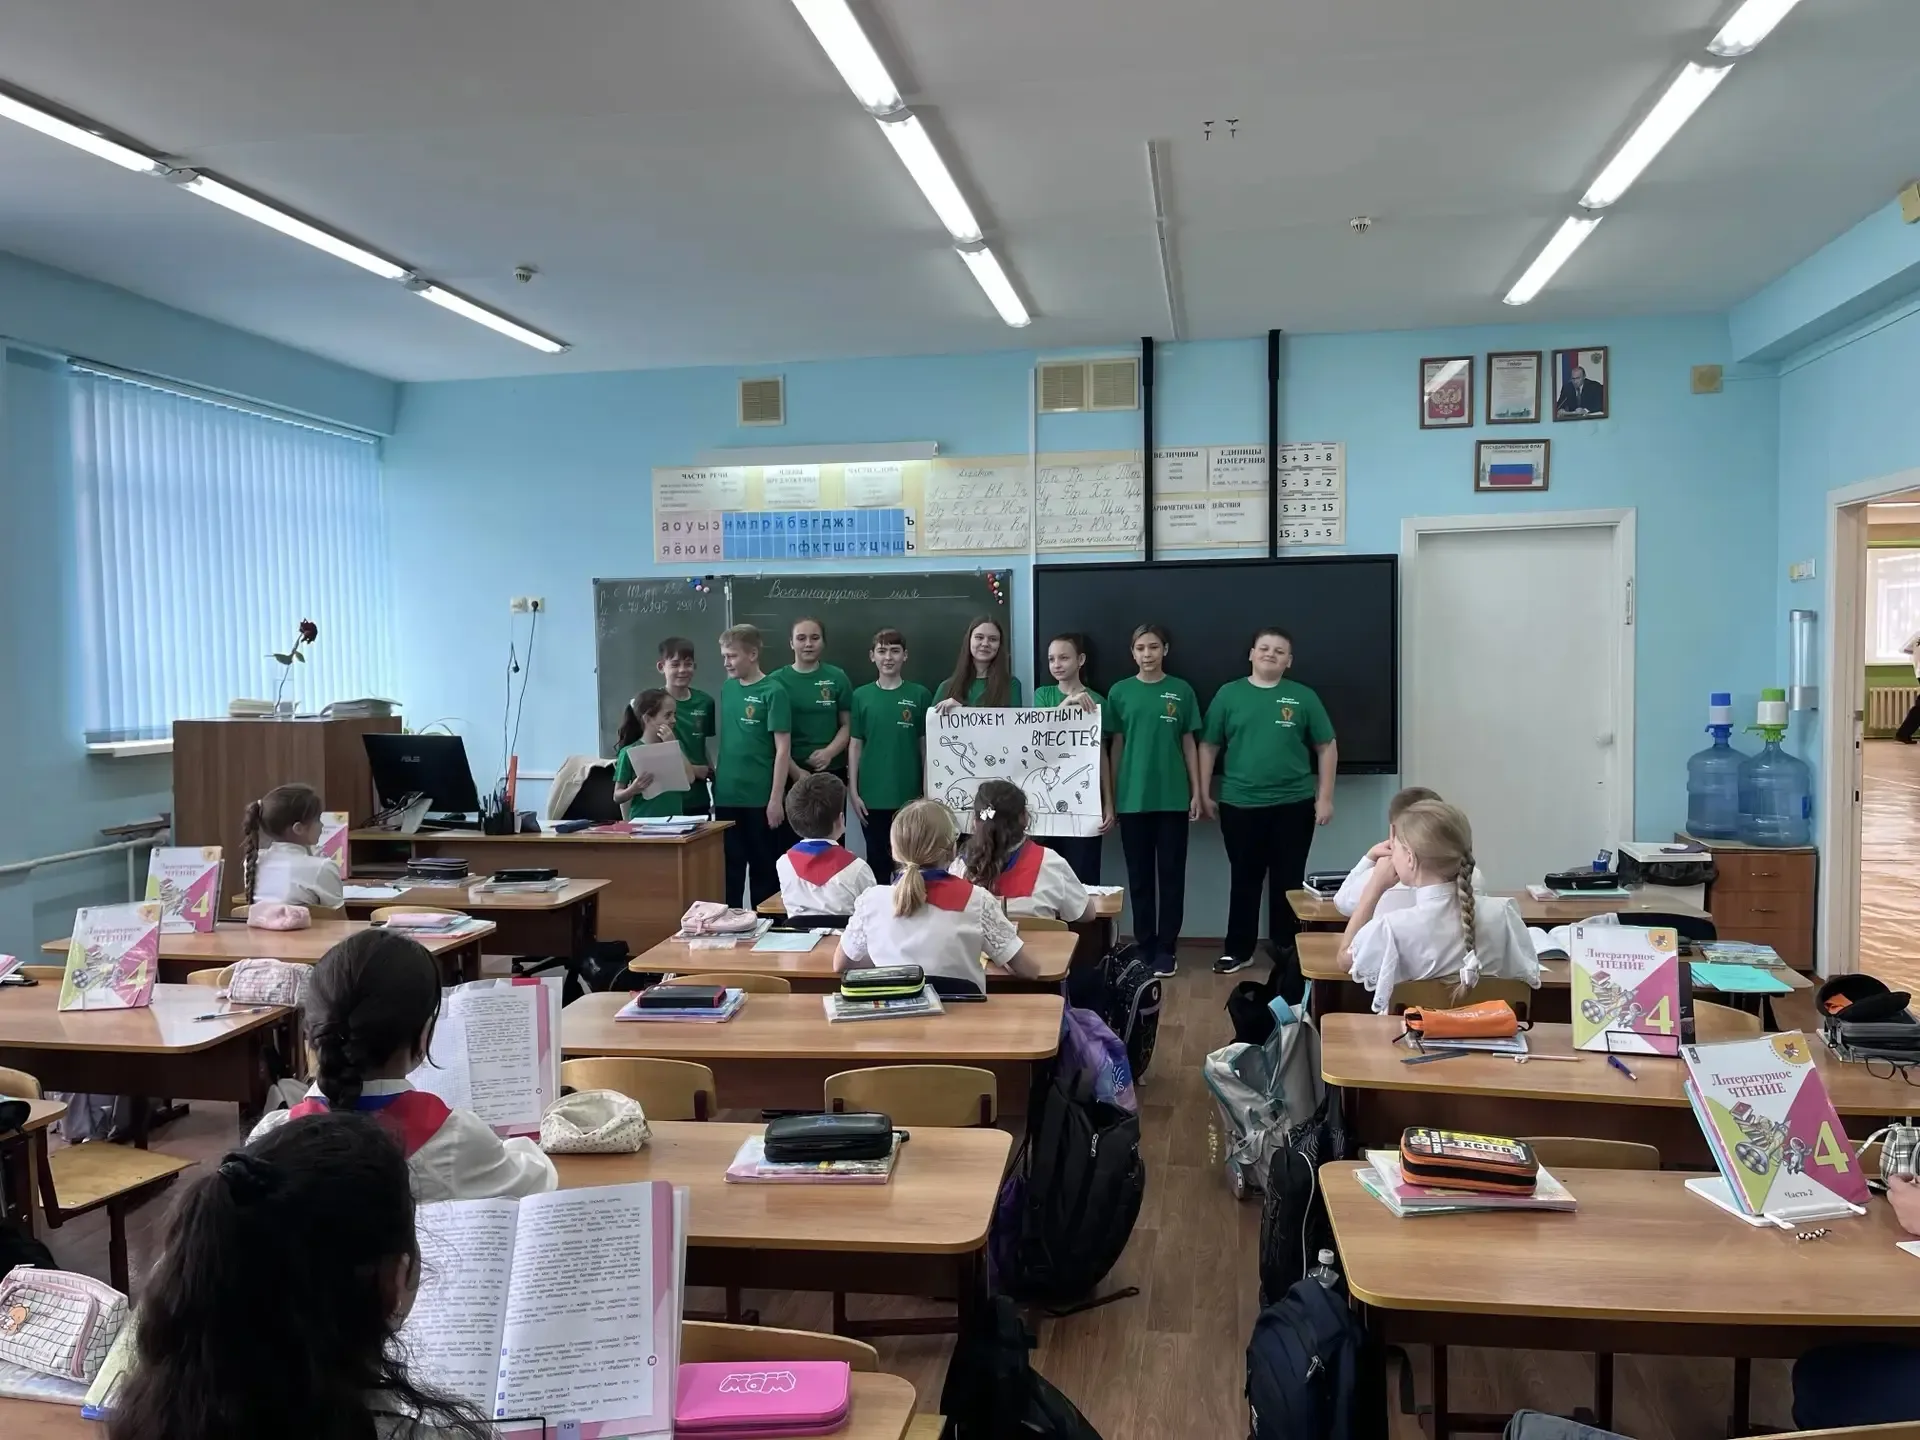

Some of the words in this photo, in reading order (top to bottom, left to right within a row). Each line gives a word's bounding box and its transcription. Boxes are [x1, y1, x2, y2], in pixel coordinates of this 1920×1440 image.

[1153, 451, 1199, 459] ВЕЛИЧИНЫ
[1217, 457, 1266, 465] ИЗМЕРЕНИЯ
[1281, 455, 1288, 463] 5
[1304, 453, 1310, 462] 3
[1326, 453, 1332, 461] 8
[1281, 479, 1288, 488] 5
[1304, 478, 1309, 487] 3
[1326, 478, 1332, 487] 2
[1283, 504, 1289, 512] 5
[1301, 504, 1307, 512] 3
[1322, 504, 1334, 512] 15
[1279, 530, 1290, 538] 15
[1304, 529, 1309, 538] 3
[1326, 529, 1332, 537] 5
[768, 579, 870, 604] Восемнадцатое
[888, 589, 920, 599] мая
[939, 713, 1005, 730] ПОМОЖЕМ
[1014, 708, 1083, 725] ЖИВОТНЫМ
[190, 891, 210, 918] 4
[1585, 948, 1655, 961] Литературное
[1596, 960, 1645, 971] ЧТЕНИЕ
[123, 959, 148, 991] 4
[1645, 995, 1674, 1035] 4
[1711, 1070, 1792, 1086] Литературное
[1727, 1082, 1787, 1098] ЧТЕНИЕ
[1454, 1141, 1511, 1153] EXCEED
[1814, 1120, 1849, 1174] 4
[1784, 1190, 1808, 1199] Часть
